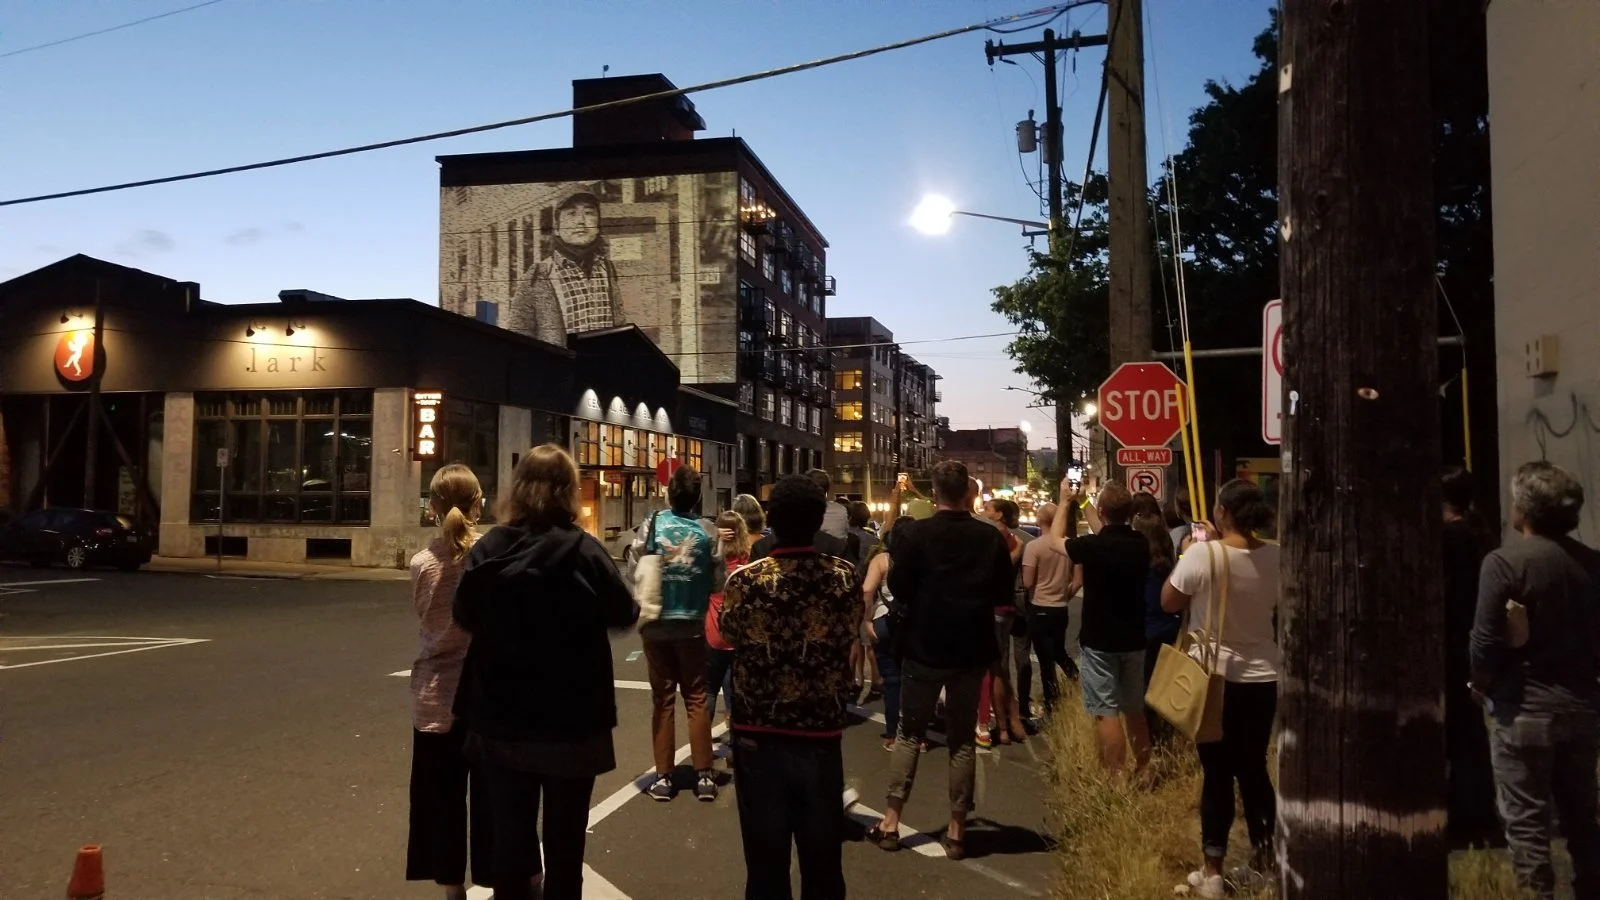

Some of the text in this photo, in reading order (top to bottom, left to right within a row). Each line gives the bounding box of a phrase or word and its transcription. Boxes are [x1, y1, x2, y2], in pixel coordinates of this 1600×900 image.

[249, 347, 327, 372] lark
[1105, 389, 1181, 421] STOP
[418, 408, 436, 455] BAR
[1122, 451, 1168, 462] ALL WAY
